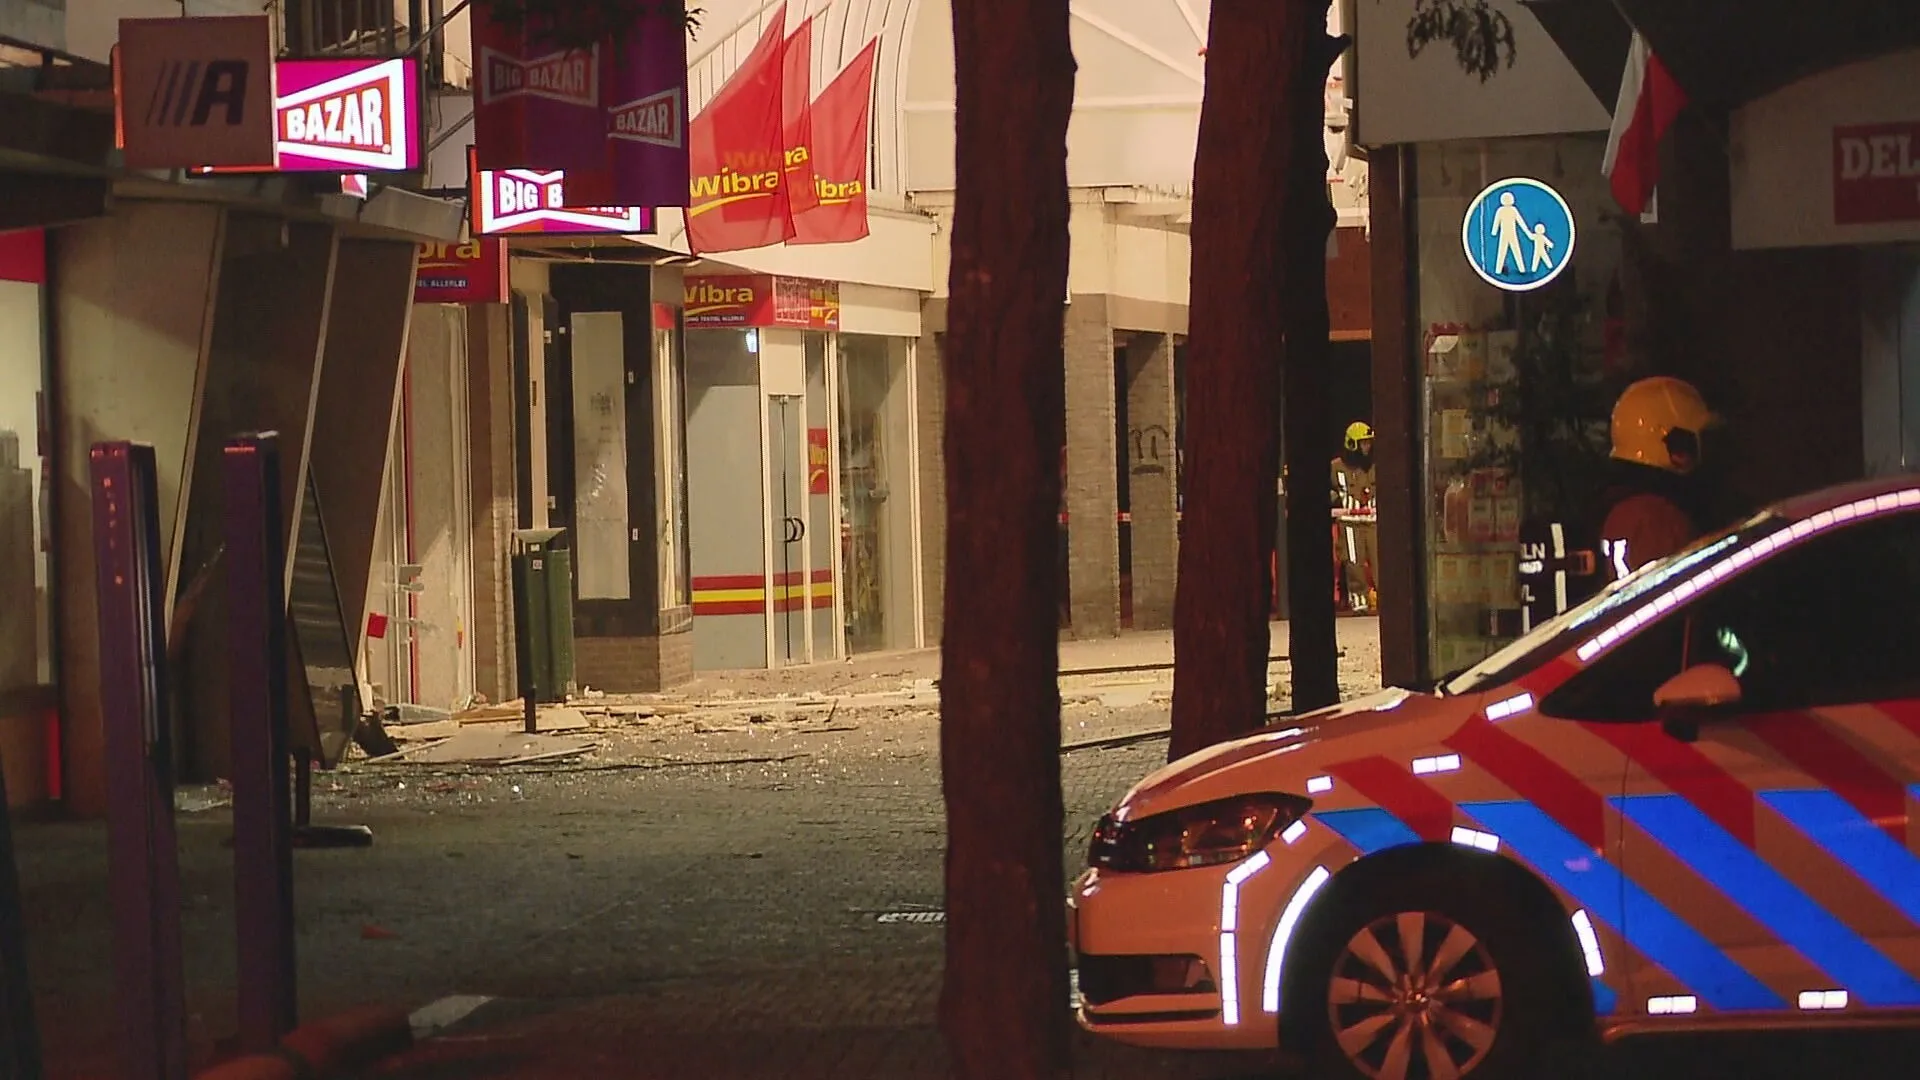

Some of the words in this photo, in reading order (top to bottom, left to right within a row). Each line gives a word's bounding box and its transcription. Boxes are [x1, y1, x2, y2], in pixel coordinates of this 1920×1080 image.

[494, 63, 523, 95] BIG
[529, 58, 585, 91] BAZAR
[286, 87, 384, 146] BAZAR
[616, 103, 669, 135] BAZAR
[499, 176, 539, 214] BIG
[690, 167, 779, 198] Wibra
[814, 174, 862, 199] ibra
